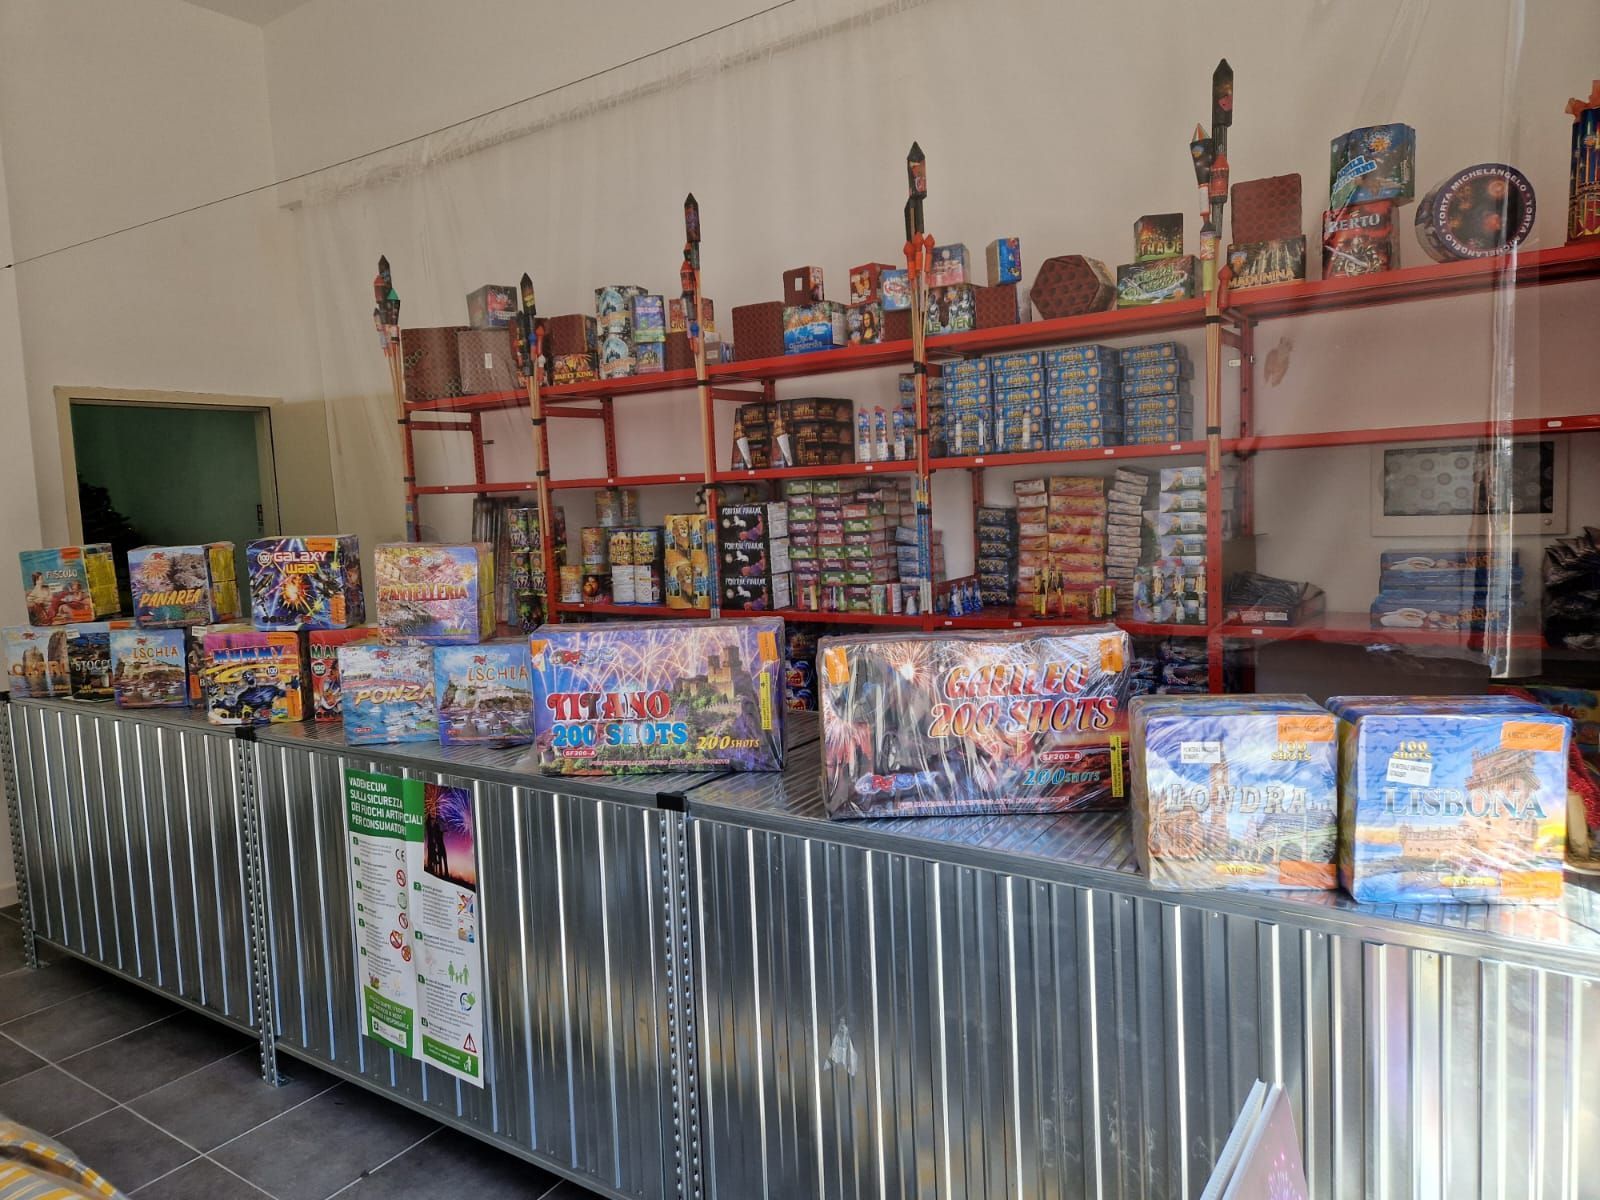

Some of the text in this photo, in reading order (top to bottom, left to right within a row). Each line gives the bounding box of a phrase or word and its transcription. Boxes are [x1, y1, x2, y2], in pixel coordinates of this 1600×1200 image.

[1439, 167, 1527, 226] TORTA MICHELANGELO
[1519, 199, 1533, 233] TORTA
[138, 588, 202, 608] PANAREA
[131, 645, 178, 659] ISCHIA
[467, 665, 529, 682] ISCHIA
[944, 662, 1089, 700] GALILEO
[354, 682, 434, 706] PONZA
[546, 690, 672, 722] TITANO
[927, 696, 1119, 738] 200 SHOTS
[552, 722, 689, 748] 200 SHOTS
[1399, 740, 1428, 752] 100
[351, 801, 360, 812] DEI
[367, 793, 403, 809] SICUREZZA
[1165, 783, 1308, 816] LONDRA
[1383, 786, 1547, 820] LISBONA
[352, 814, 362, 825] PER
